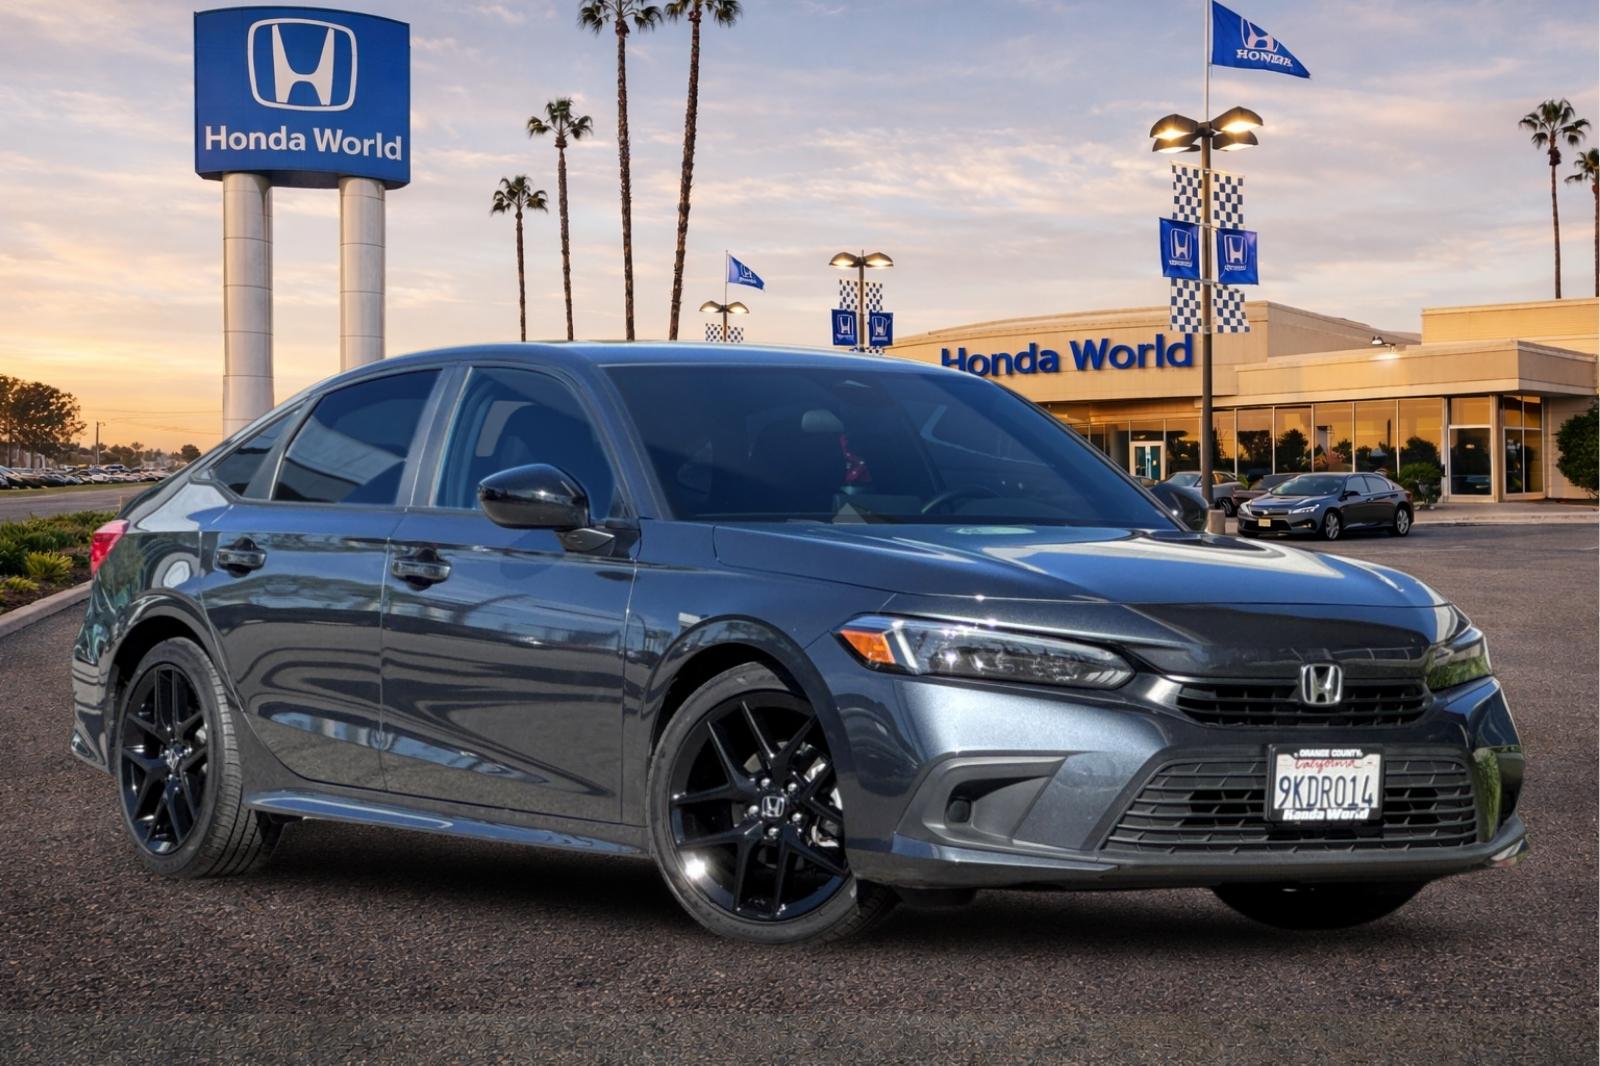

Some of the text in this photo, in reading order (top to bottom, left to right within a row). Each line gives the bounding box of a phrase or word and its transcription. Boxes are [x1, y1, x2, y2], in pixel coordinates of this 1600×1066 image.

[205, 125, 402, 160] Honda World
[941, 333, 1193, 377] Honda World
[1294, 758, 1359, 774] California
[1279, 775, 1374, 809] 9KDR014
